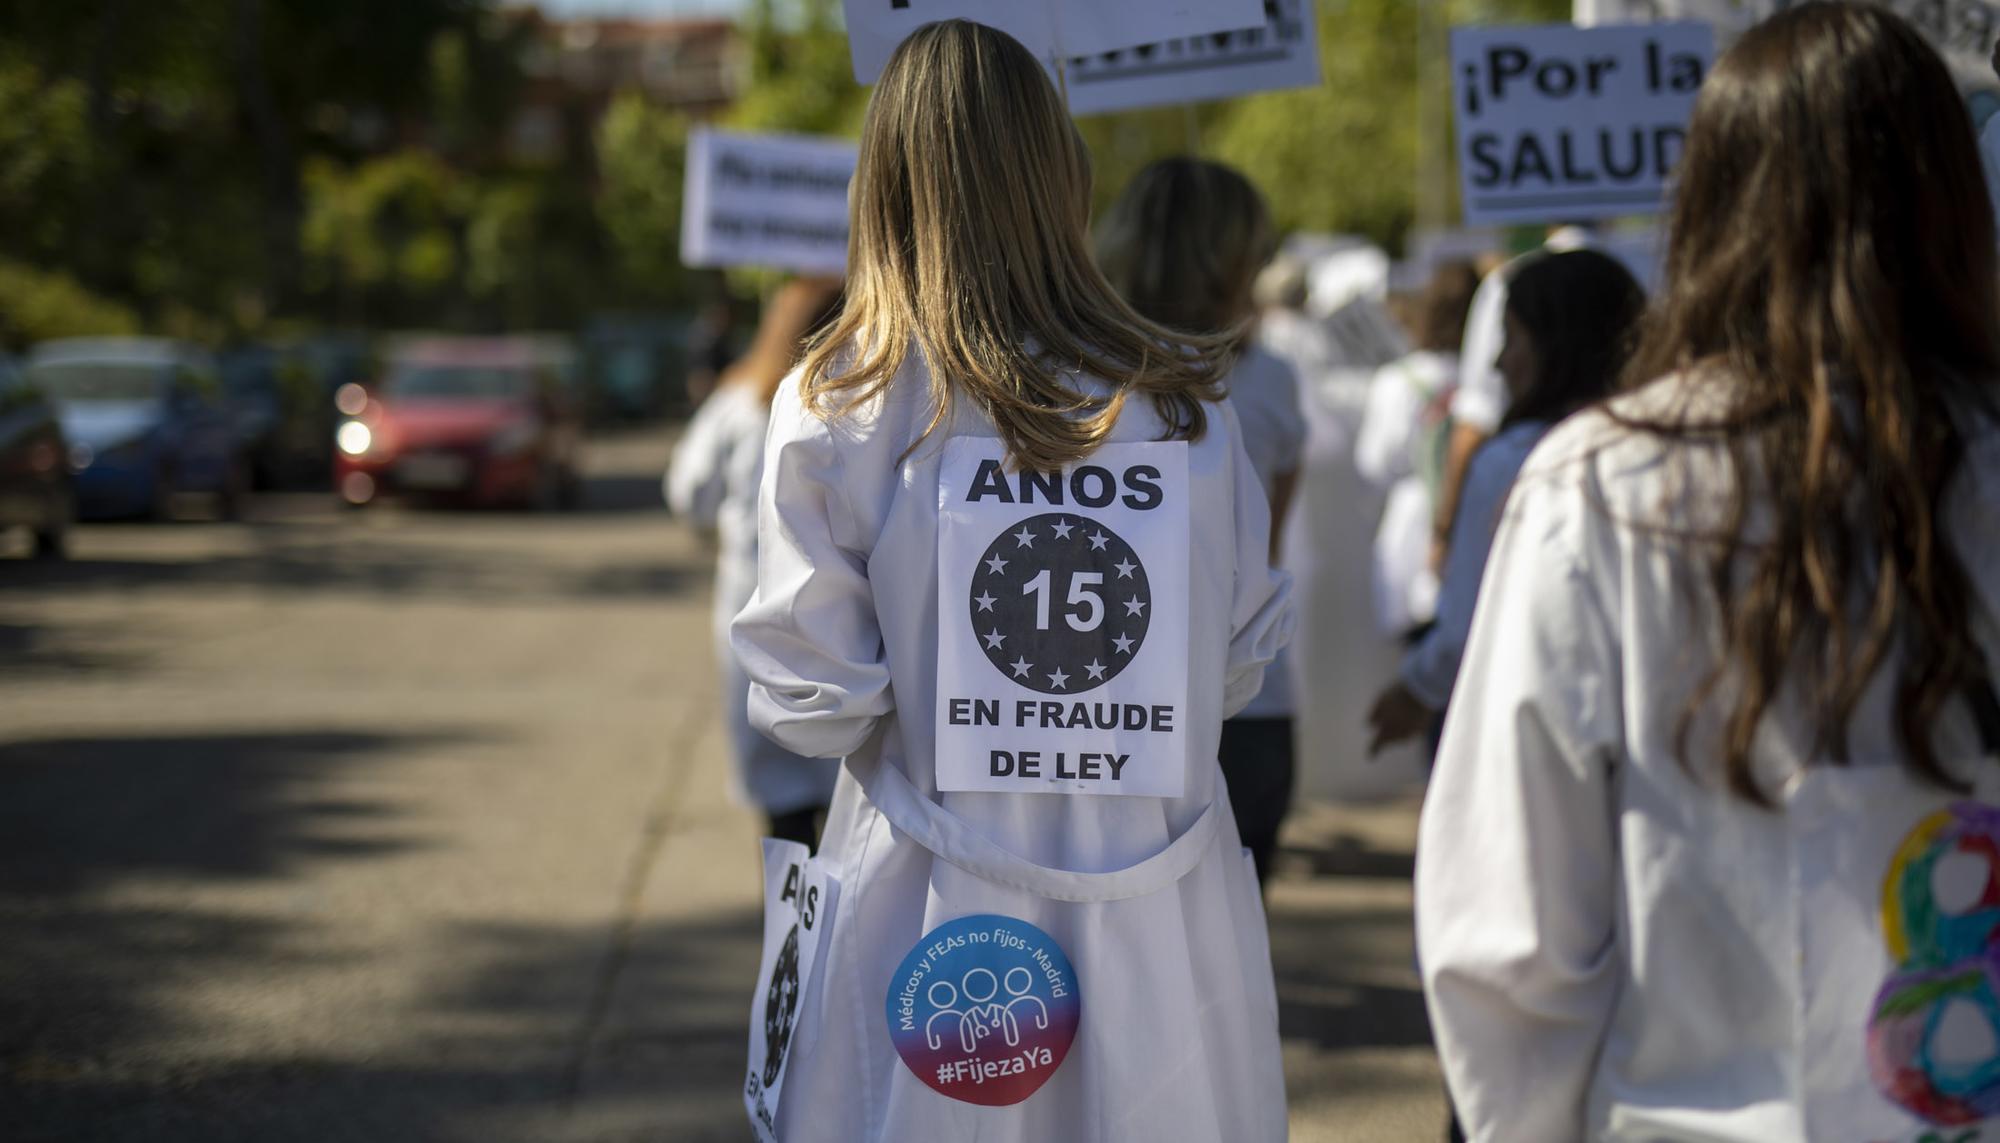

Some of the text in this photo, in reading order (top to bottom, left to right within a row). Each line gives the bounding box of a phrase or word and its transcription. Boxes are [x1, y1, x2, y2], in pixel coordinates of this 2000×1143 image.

[1463, 38, 1704, 115] ¡Por la
[1022, 569, 1105, 632] 15
[949, 698, 1174, 732] EN FRAUDE
[990, 750, 1130, 781] DE LEY
[926, 935, 966, 961] FEAs
[969, 931, 989, 944] no
[993, 928, 1026, 951] fijos
[921, 959, 932, 973] y
[1032, 948, 1068, 999] Madrid
[899, 968, 924, 1031] Médicos
[936, 1046, 1053, 1084] #FijezaYa
